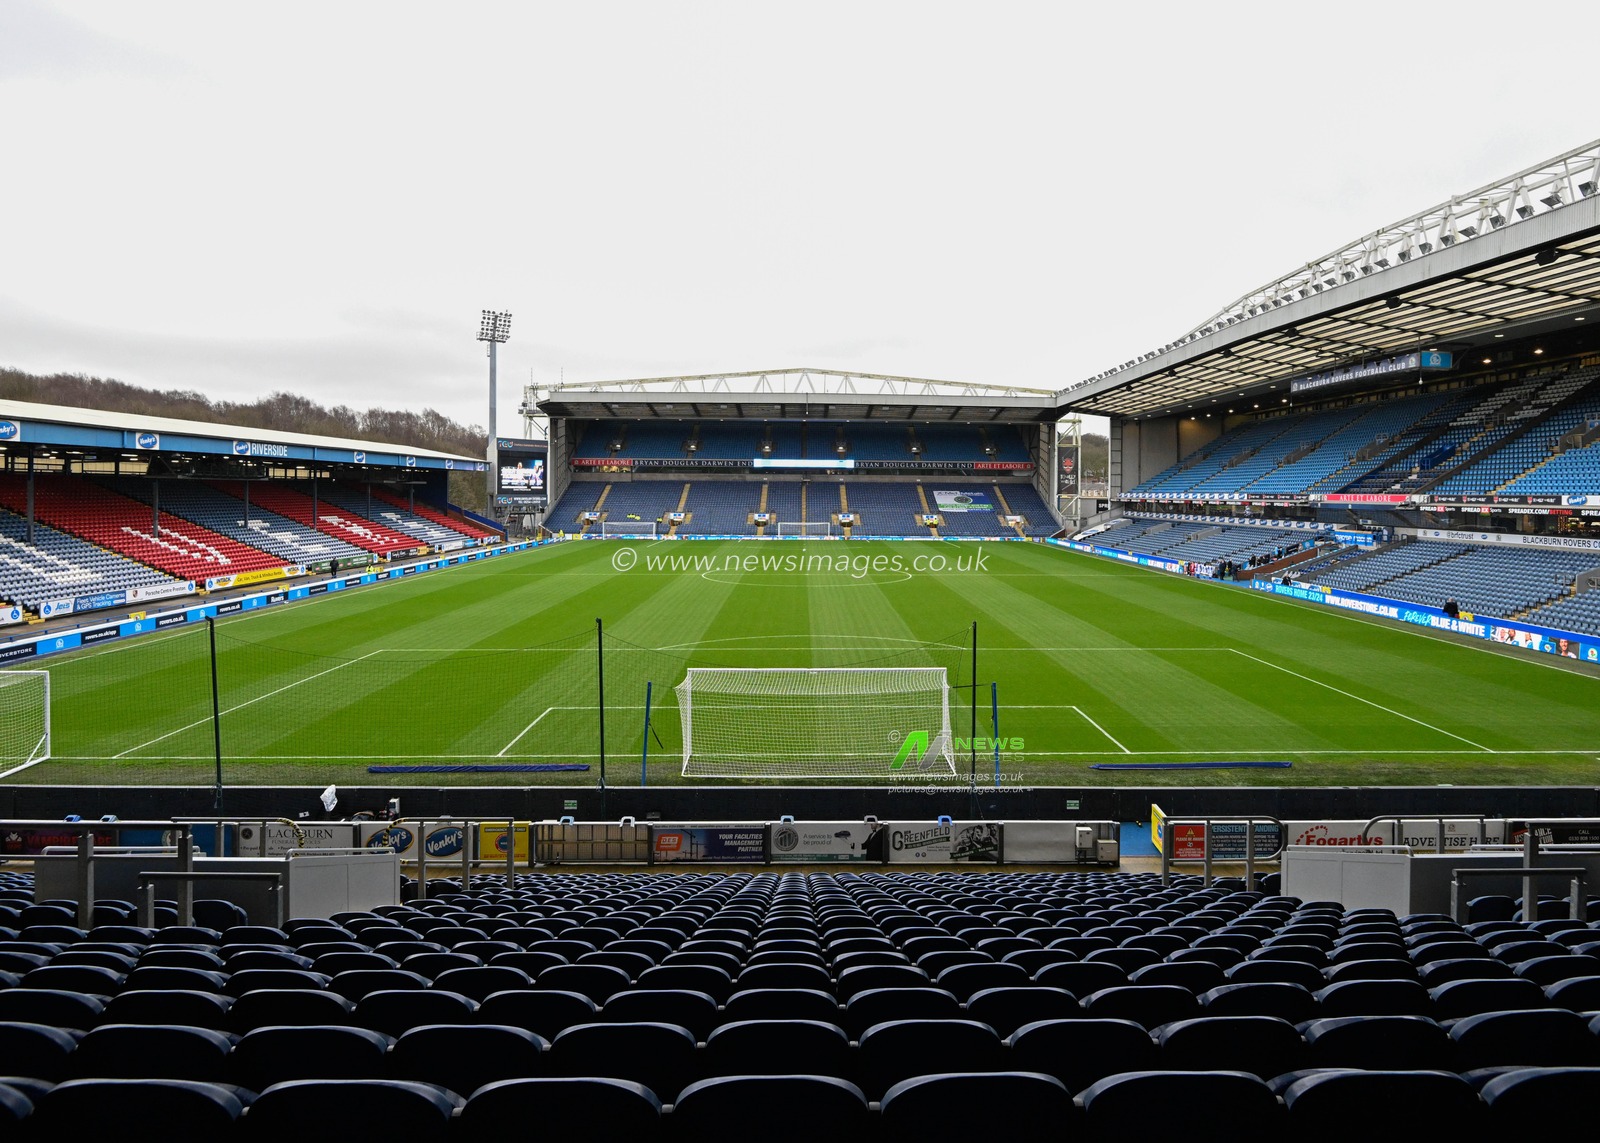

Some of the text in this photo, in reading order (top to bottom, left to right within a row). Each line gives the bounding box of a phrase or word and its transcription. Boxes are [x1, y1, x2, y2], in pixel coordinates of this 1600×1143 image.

[1300, 362, 1405, 390] BLACKBURN ROVERS FOOTBALL CLUB
[252, 443, 288, 457] RIVERSIDE
[1340, 494, 1391, 502] ARTE ET LABORE
[1522, 536, 1562, 546] BLACKBURN
[1563, 539, 1591, 548] ROVERS
[1275, 584, 1293, 596] ROVERS
[1308, 591, 1323, 602] 23/24
[1430, 615, 1450, 630] BLUE
[1457, 620, 1486, 637] WHITE
[0, 647, 33, 659] VERSTORE
[1212, 825, 1279, 833] ERSISTENT ANDING
[370, 831, 407, 849] Veky's
[427, 830, 463, 854] Venky's
[1403, 836, 1500, 847] ADVETISE HRE
